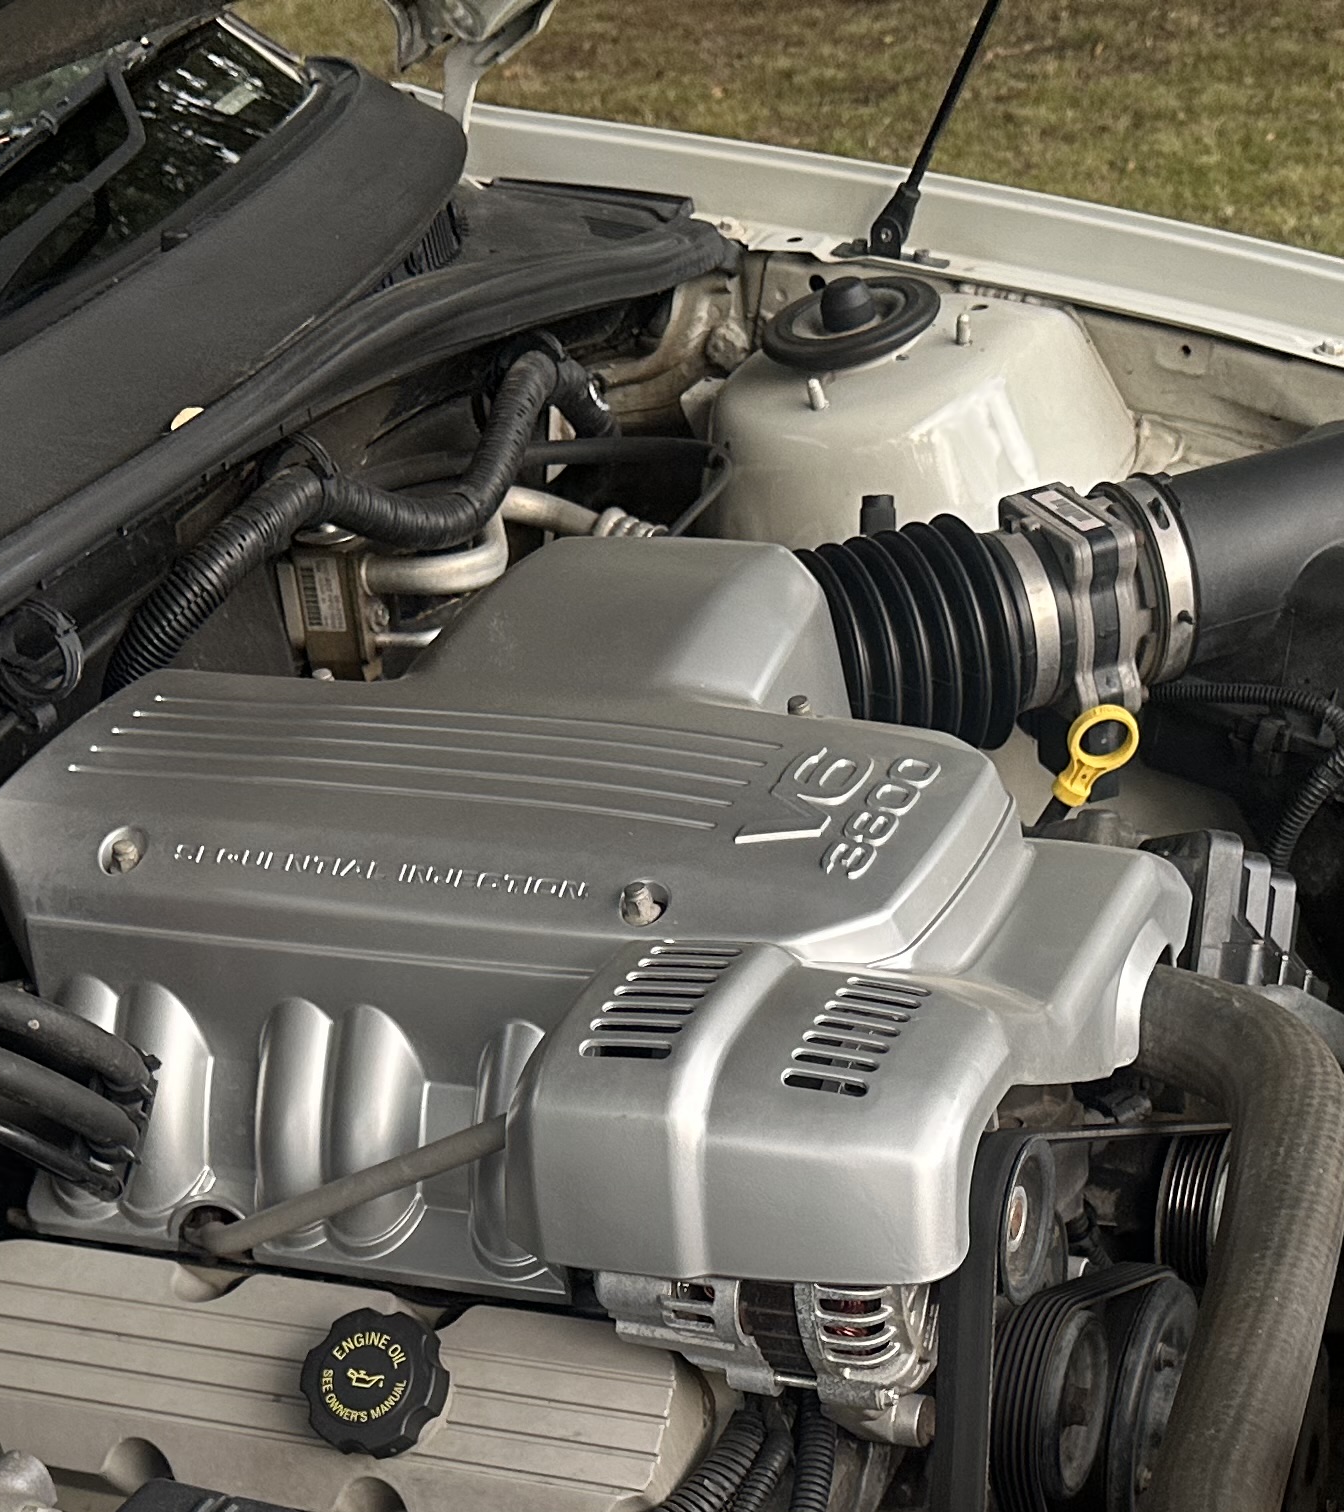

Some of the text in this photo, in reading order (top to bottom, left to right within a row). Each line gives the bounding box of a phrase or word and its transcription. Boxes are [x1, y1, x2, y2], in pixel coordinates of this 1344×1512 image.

[734, 747, 874, 844] V6
[820, 757, 941, 880] 3800
[173, 840, 595, 903] SEQUENTIAL INJECTION
[333, 1331, 407, 1369] ENGINE OIL
[322, 1368, 407, 1423] SEE OWNER'S MANUAL
